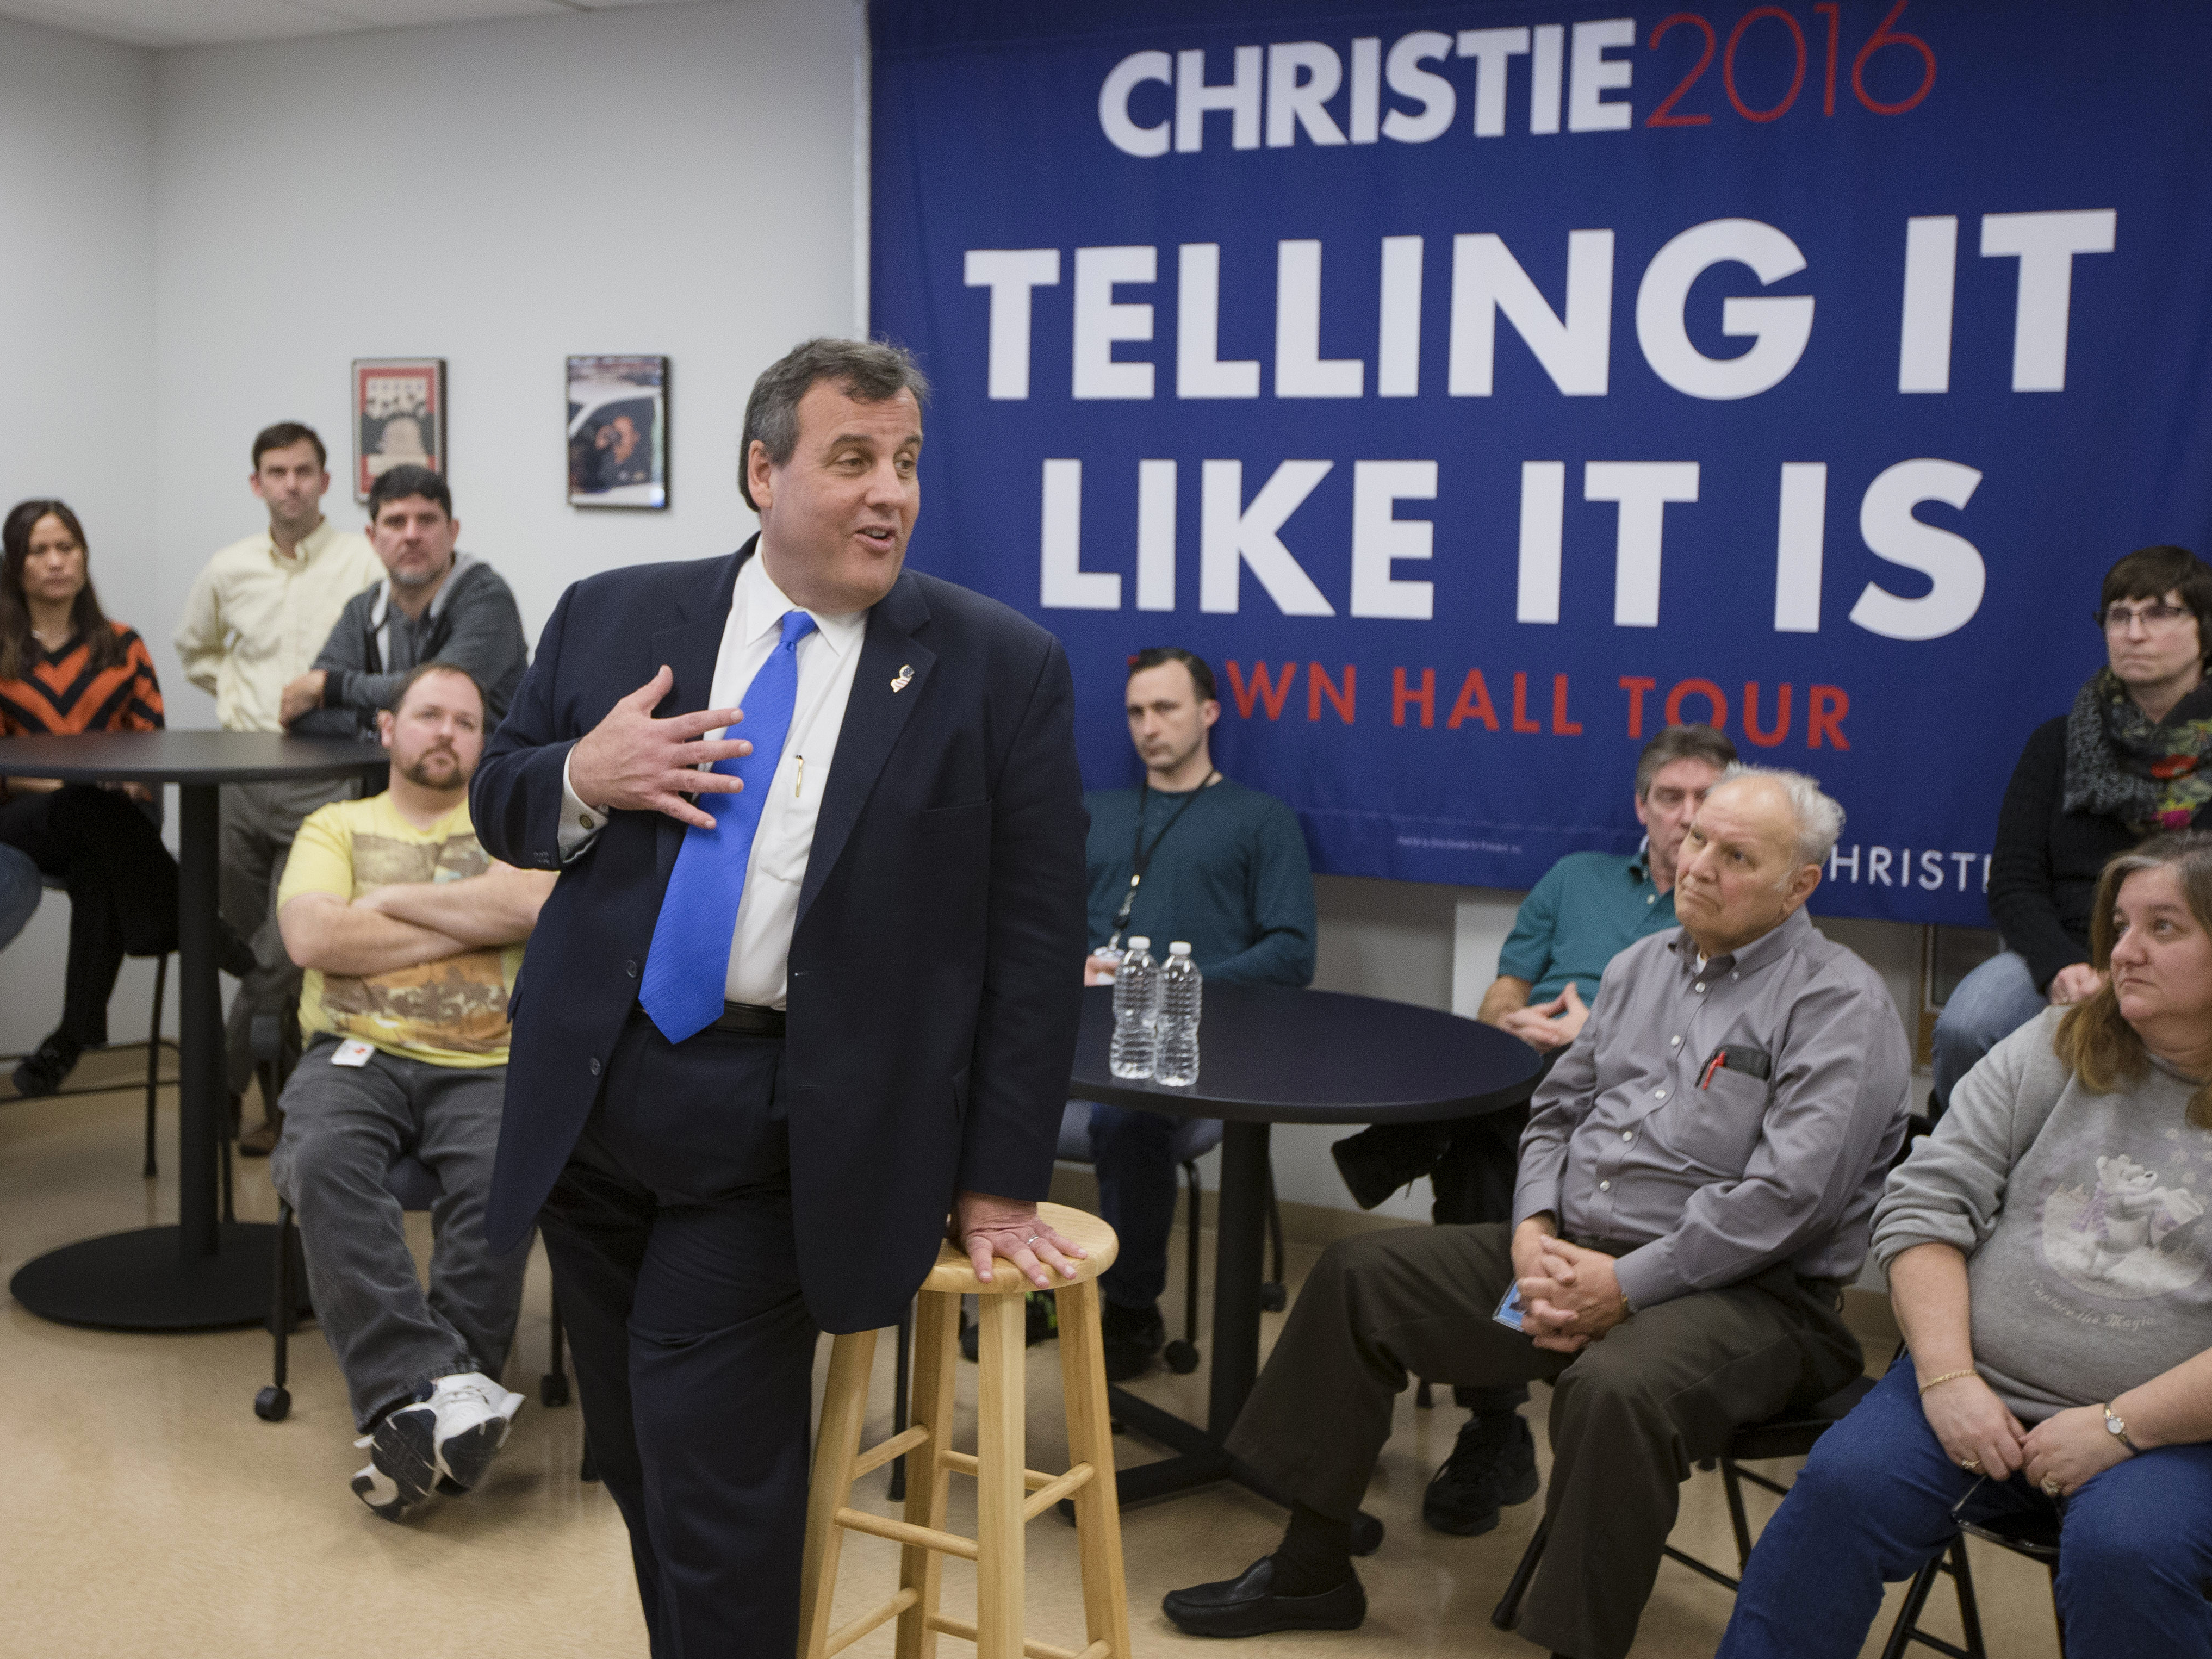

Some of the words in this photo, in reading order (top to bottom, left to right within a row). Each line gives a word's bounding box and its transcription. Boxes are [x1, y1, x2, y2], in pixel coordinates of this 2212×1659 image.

[1099, 18, 1636, 158] CHRISTIE
[1644, 0, 1937, 128] 2016
[963, 218, 1816, 401] TELLING
[1898, 208, 2117, 395] IT
[1039, 457, 1439, 622] LIKE
[1515, 459, 1701, 628] IT
[1773, 457, 1986, 642] IS
[1391, 667, 1583, 736] HALL
[1618, 676, 1851, 751] TOUR
[1829, 843, 1992, 894] HRISTI
